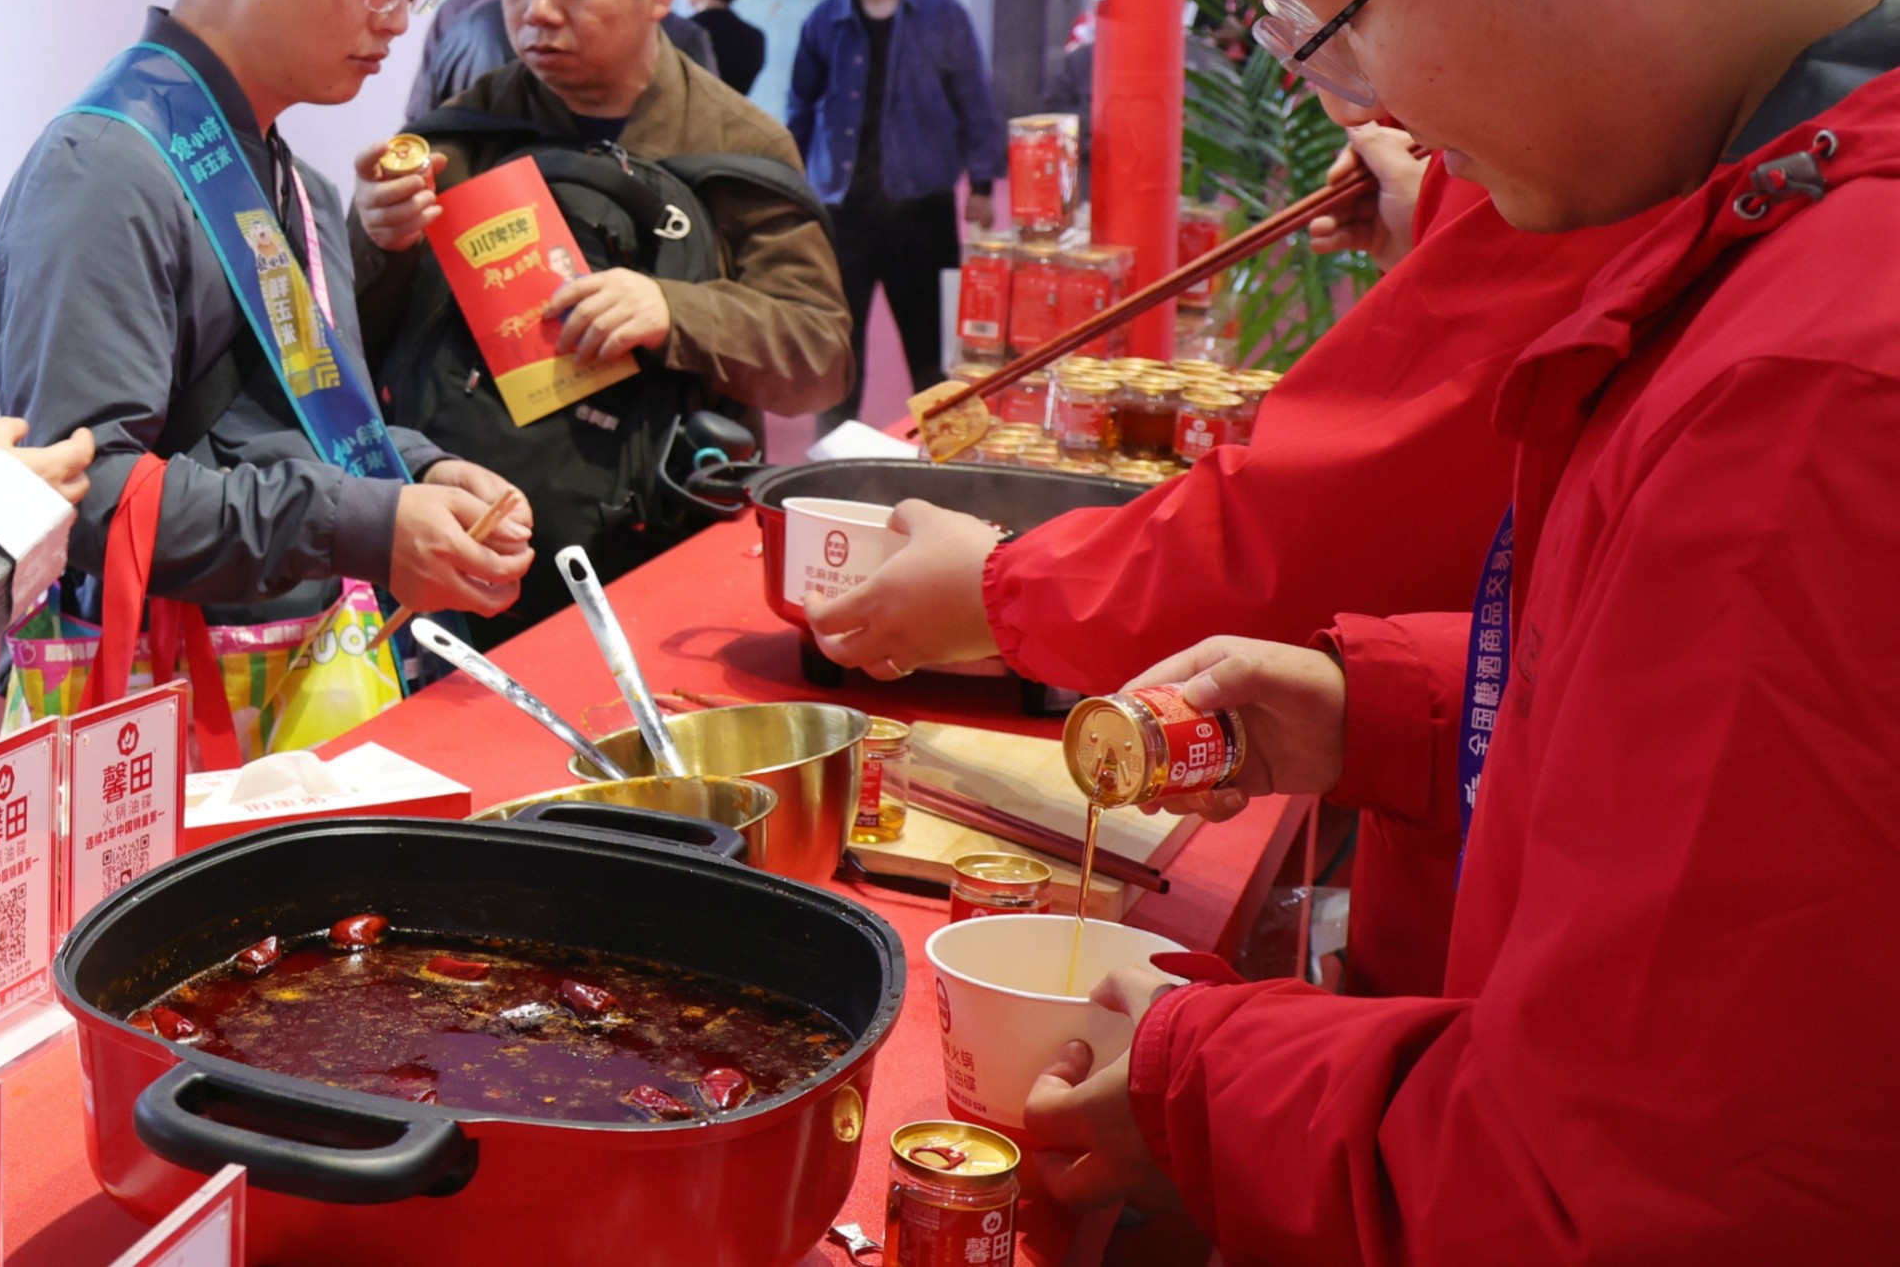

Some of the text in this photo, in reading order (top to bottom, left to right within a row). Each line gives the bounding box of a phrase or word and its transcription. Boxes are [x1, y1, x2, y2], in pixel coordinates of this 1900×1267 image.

[189, 146, 233, 184] 鲜玉米
[102, 752, 153, 804] 馨田
[102, 793, 152, 827] 火锅油碟
[85, 810, 165, 850] 连续2年中国销量第一
[964, 1230, 1012, 1264] 馨田
